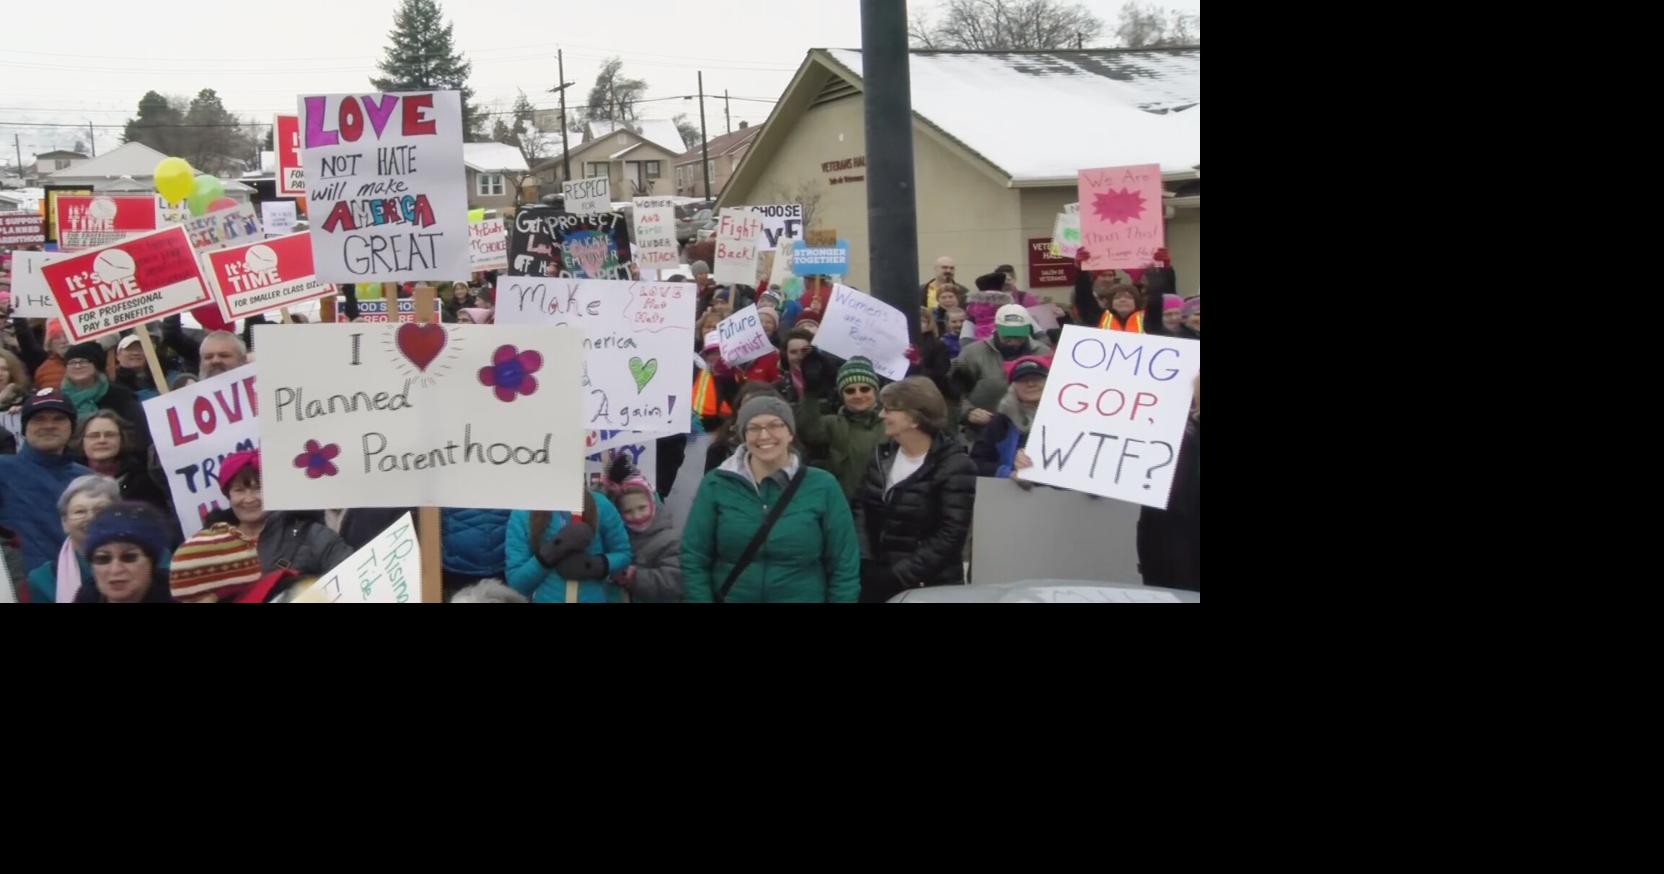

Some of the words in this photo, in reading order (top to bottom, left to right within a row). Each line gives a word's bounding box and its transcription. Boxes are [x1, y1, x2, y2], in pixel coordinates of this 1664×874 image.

[304, 93, 437, 149] LOVE
[321, 153, 362, 177] NOT
[377, 145, 417, 176] HATE
[311, 182, 347, 201] will
[357, 179, 408, 197] make
[564, 179, 608, 200] RESPECT
[321, 194, 436, 234] AMERICA
[545, 212, 624, 240] PROTECT
[720, 215, 759, 241] Fight
[343, 232, 443, 275] GREAT
[717, 244, 756, 261] Back!
[794, 247, 846, 256] STRONGER
[794, 256, 847, 265] TOGETHER
[65, 271, 100, 292] It's
[224, 260, 250, 277] It's
[228, 269, 282, 293] TIME
[70, 275, 142, 310] TIME
[78, 311, 99, 323] FOR
[99, 291, 163, 318] PROFESSIONAL
[235, 299, 249, 308] FOR
[249, 289, 283, 305] SMALLER
[283, 284, 305, 296] CLASS
[510, 283, 601, 317] Make
[83, 320, 101, 333] PAY
[114, 305, 154, 324] BENEFITS
[719, 313, 757, 341] Future
[349, 333, 362, 366] I
[1072, 338, 1180, 381] OMG
[274, 378, 414, 422] Planned
[361, 424, 552, 474] Parenthood
[1041, 425, 1174, 490] WTF?
[357, 548, 383, 601] Tide
